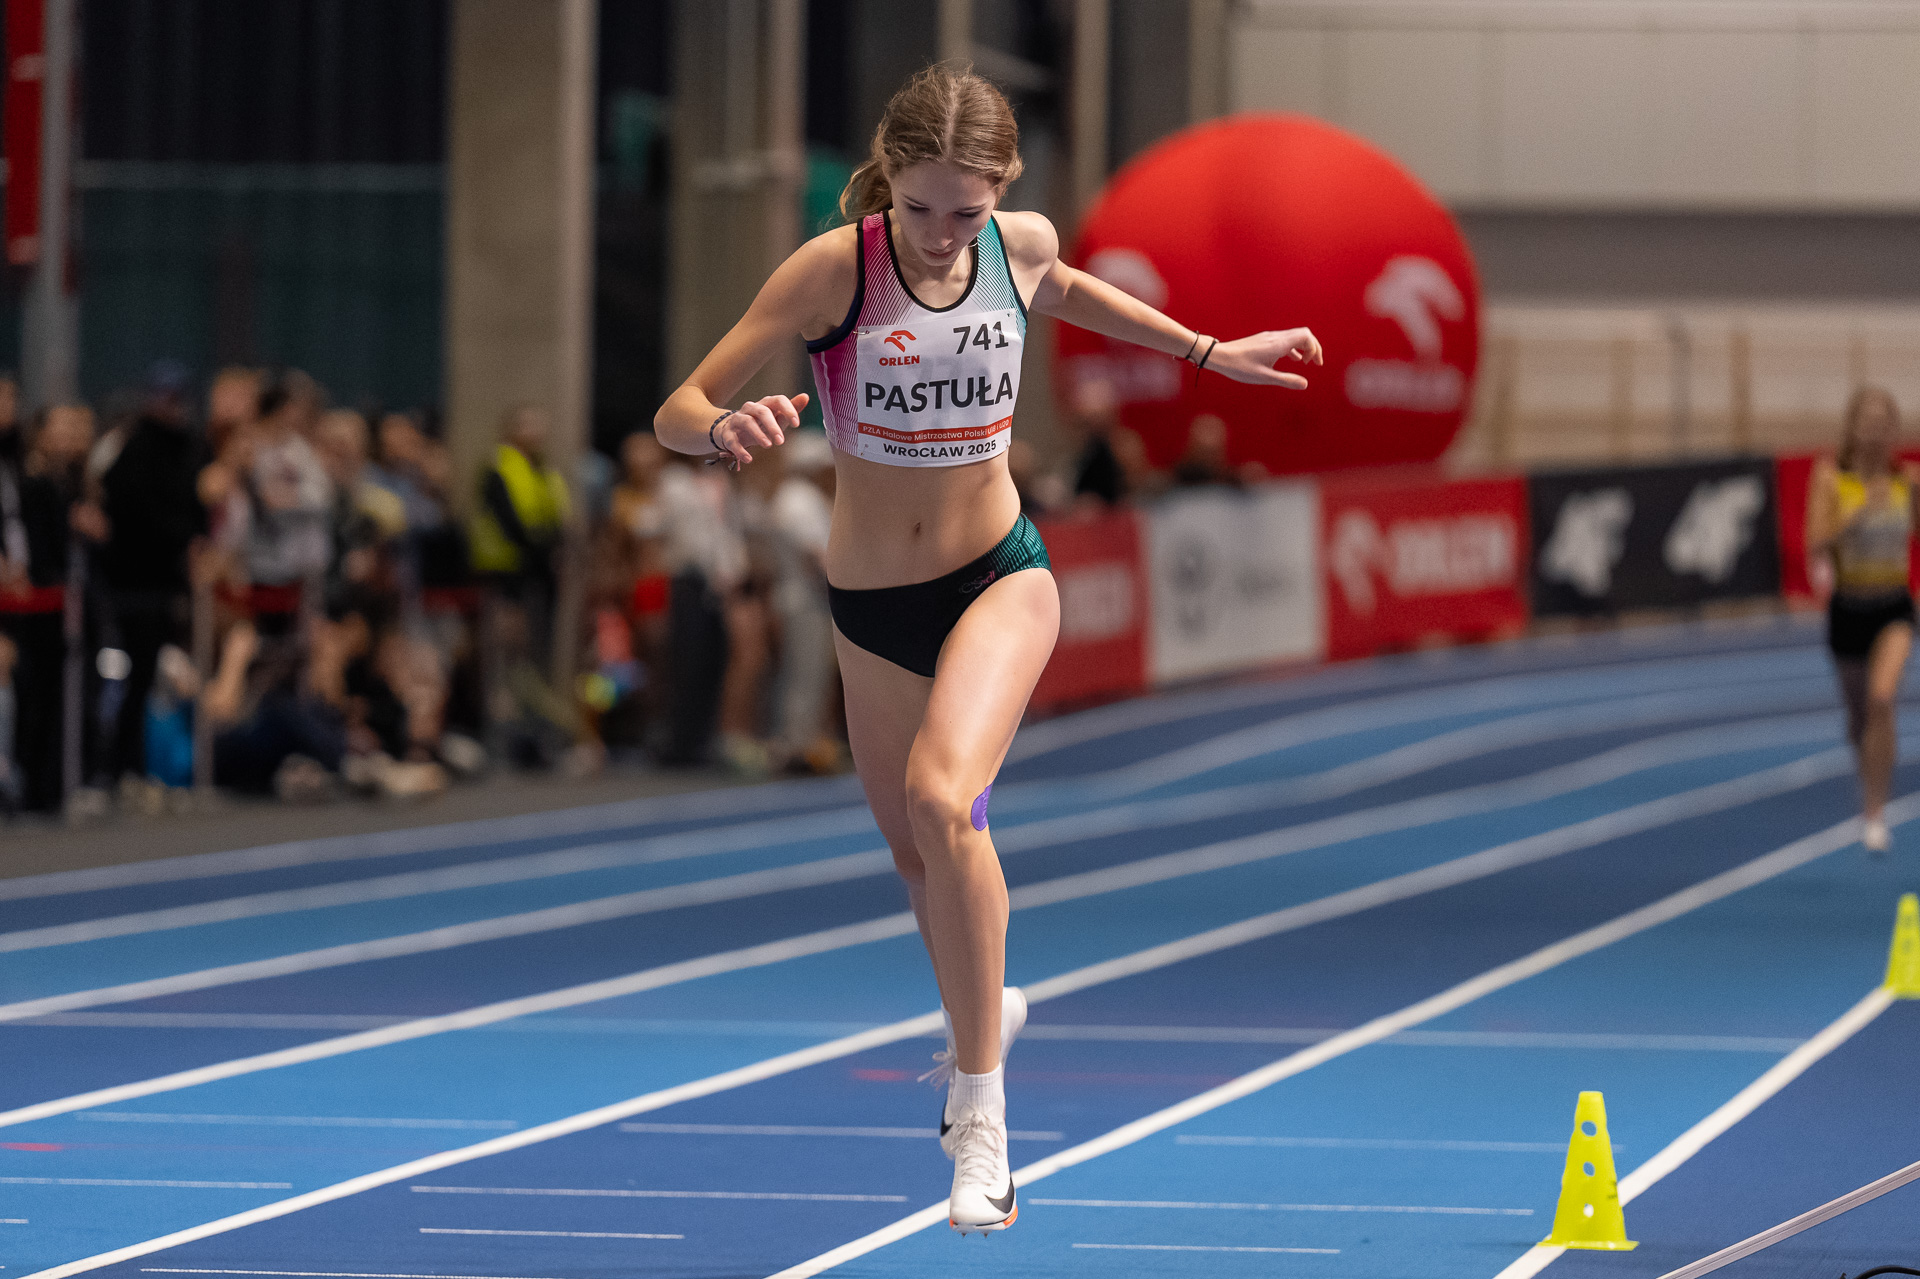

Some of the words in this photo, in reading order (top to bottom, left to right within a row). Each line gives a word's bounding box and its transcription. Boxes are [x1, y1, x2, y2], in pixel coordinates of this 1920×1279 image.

[953, 321, 1009, 354] 741
[879, 355, 920, 366] ORLEN
[865, 372, 1013, 413] PASTUŁA
[862, 425, 881, 435] PZLA
[882, 430, 913, 441] Halowe
[914, 430, 963, 441] Mistrzostwa
[964, 428, 988, 438] Polski
[883, 443, 964, 458] WROCŁAW
[968, 439, 997, 456] 2025
